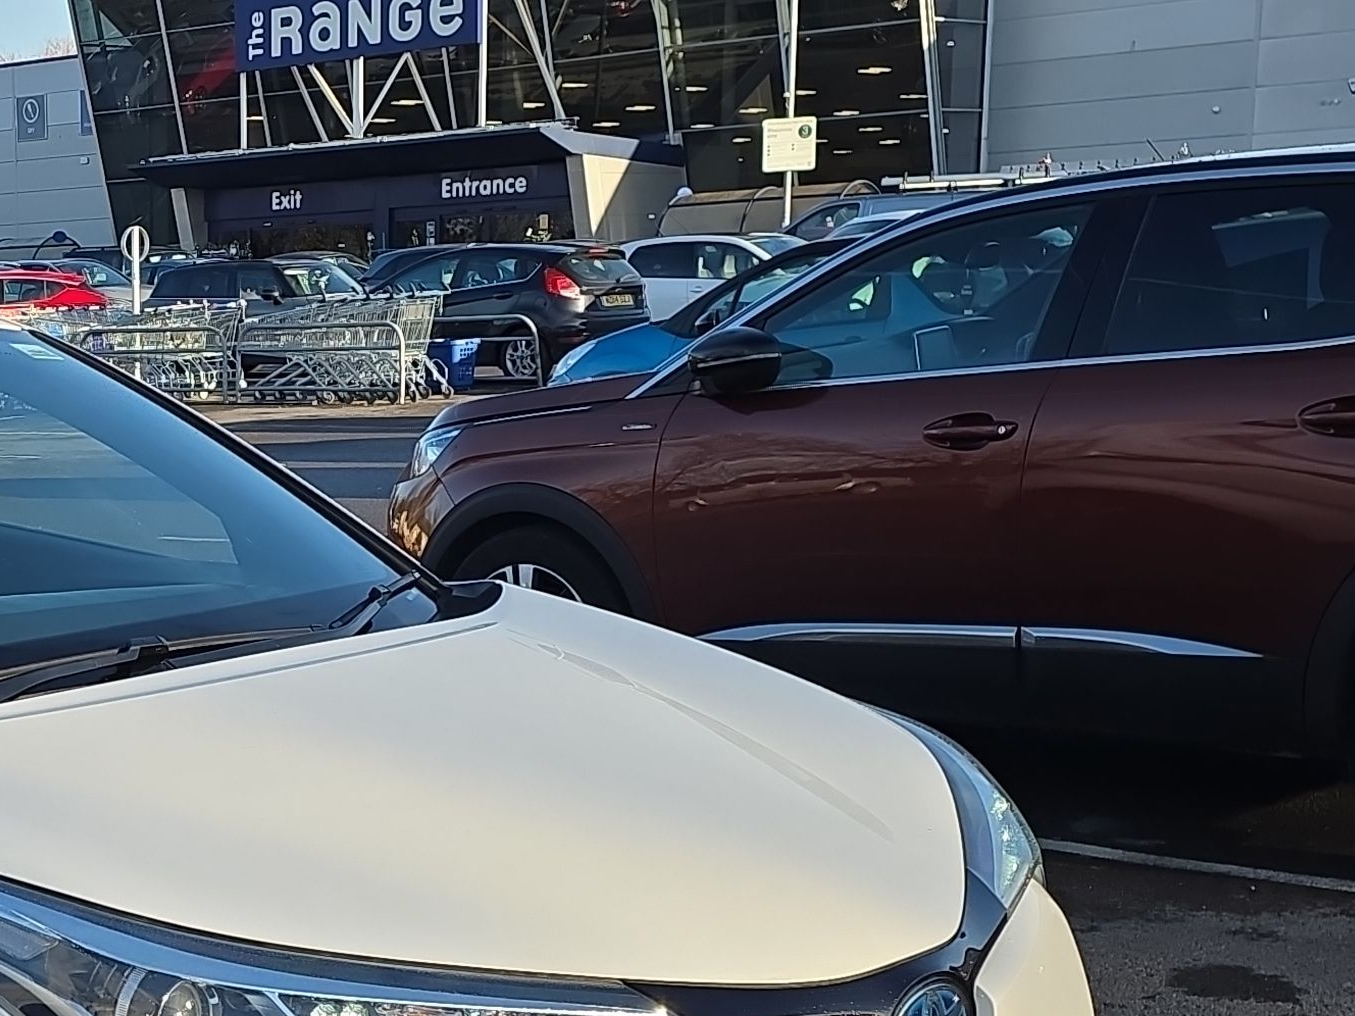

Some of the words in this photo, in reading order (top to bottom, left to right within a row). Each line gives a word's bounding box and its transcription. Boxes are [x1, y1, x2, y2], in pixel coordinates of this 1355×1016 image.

[247, 11, 265, 61] The
[441, 176, 528, 199] Entrance
[271, 189, 303, 211] Exit
